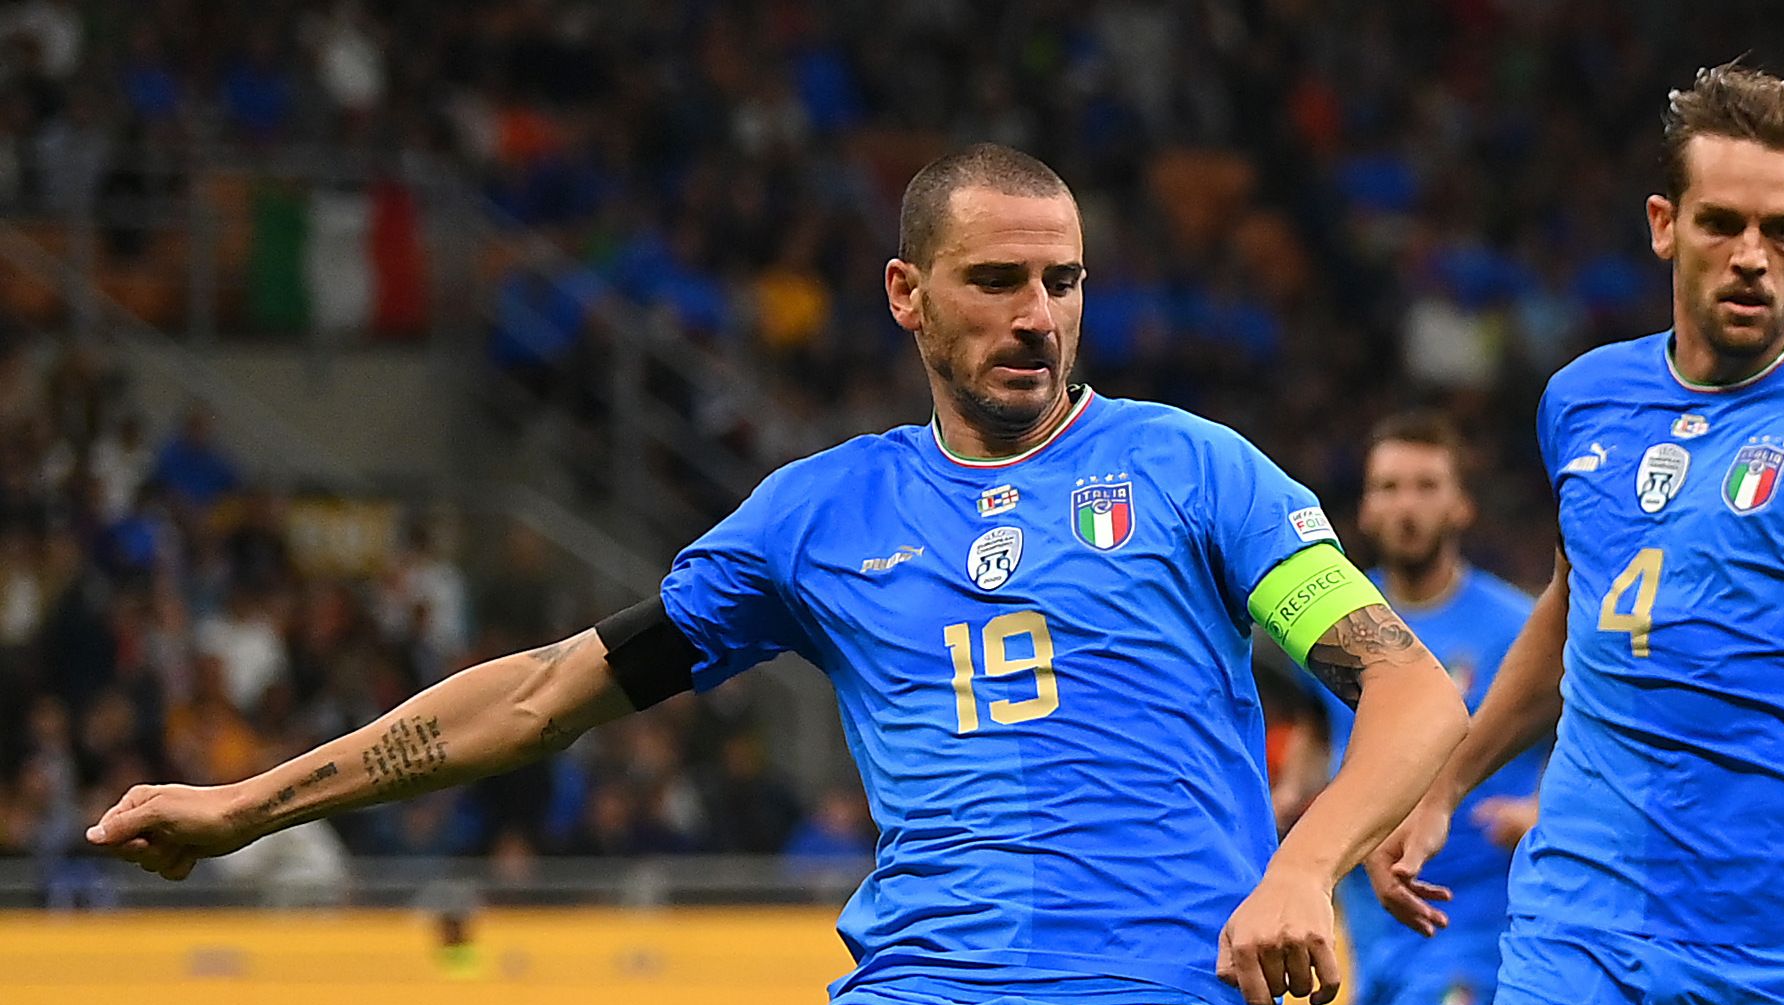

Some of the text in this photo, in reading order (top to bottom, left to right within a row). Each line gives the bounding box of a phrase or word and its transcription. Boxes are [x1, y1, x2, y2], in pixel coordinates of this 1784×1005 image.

[1076, 488, 1127, 503] ITALIA
[1280, 568, 1346, 621] RESPECT
[1597, 547, 1664, 657] 4
[944, 609, 1060, 735] 19
